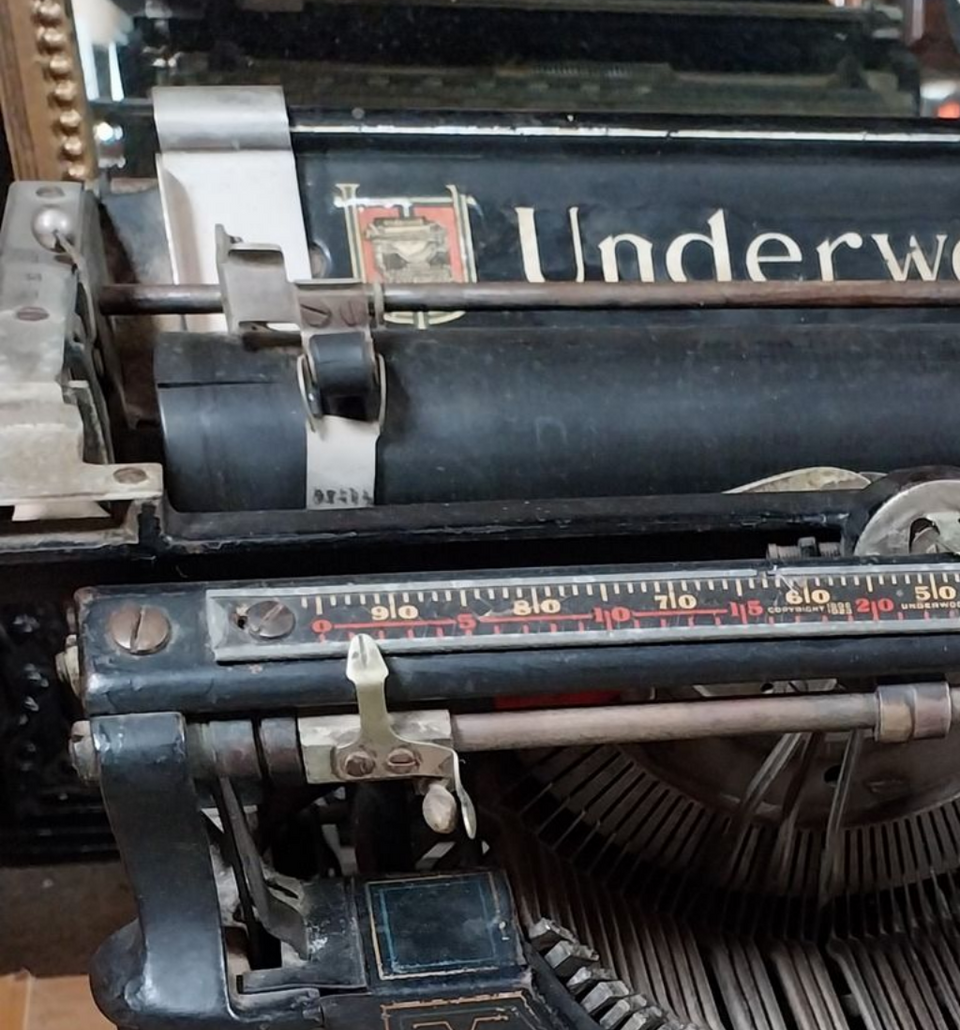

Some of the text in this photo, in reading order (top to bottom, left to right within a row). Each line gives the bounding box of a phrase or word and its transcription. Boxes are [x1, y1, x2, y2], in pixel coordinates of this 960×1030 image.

[371, 605, 419, 621] 90
[513, 599, 561, 616] 80
[654, 594, 697, 610] 70
[785, 588, 831, 605] 60
[914, 585, 957, 601] 50
[457, 613, 477, 630] 5
[592, 606, 631, 623] 10
[729, 600, 764, 617] 15
[855, 598, 895, 613] 20
